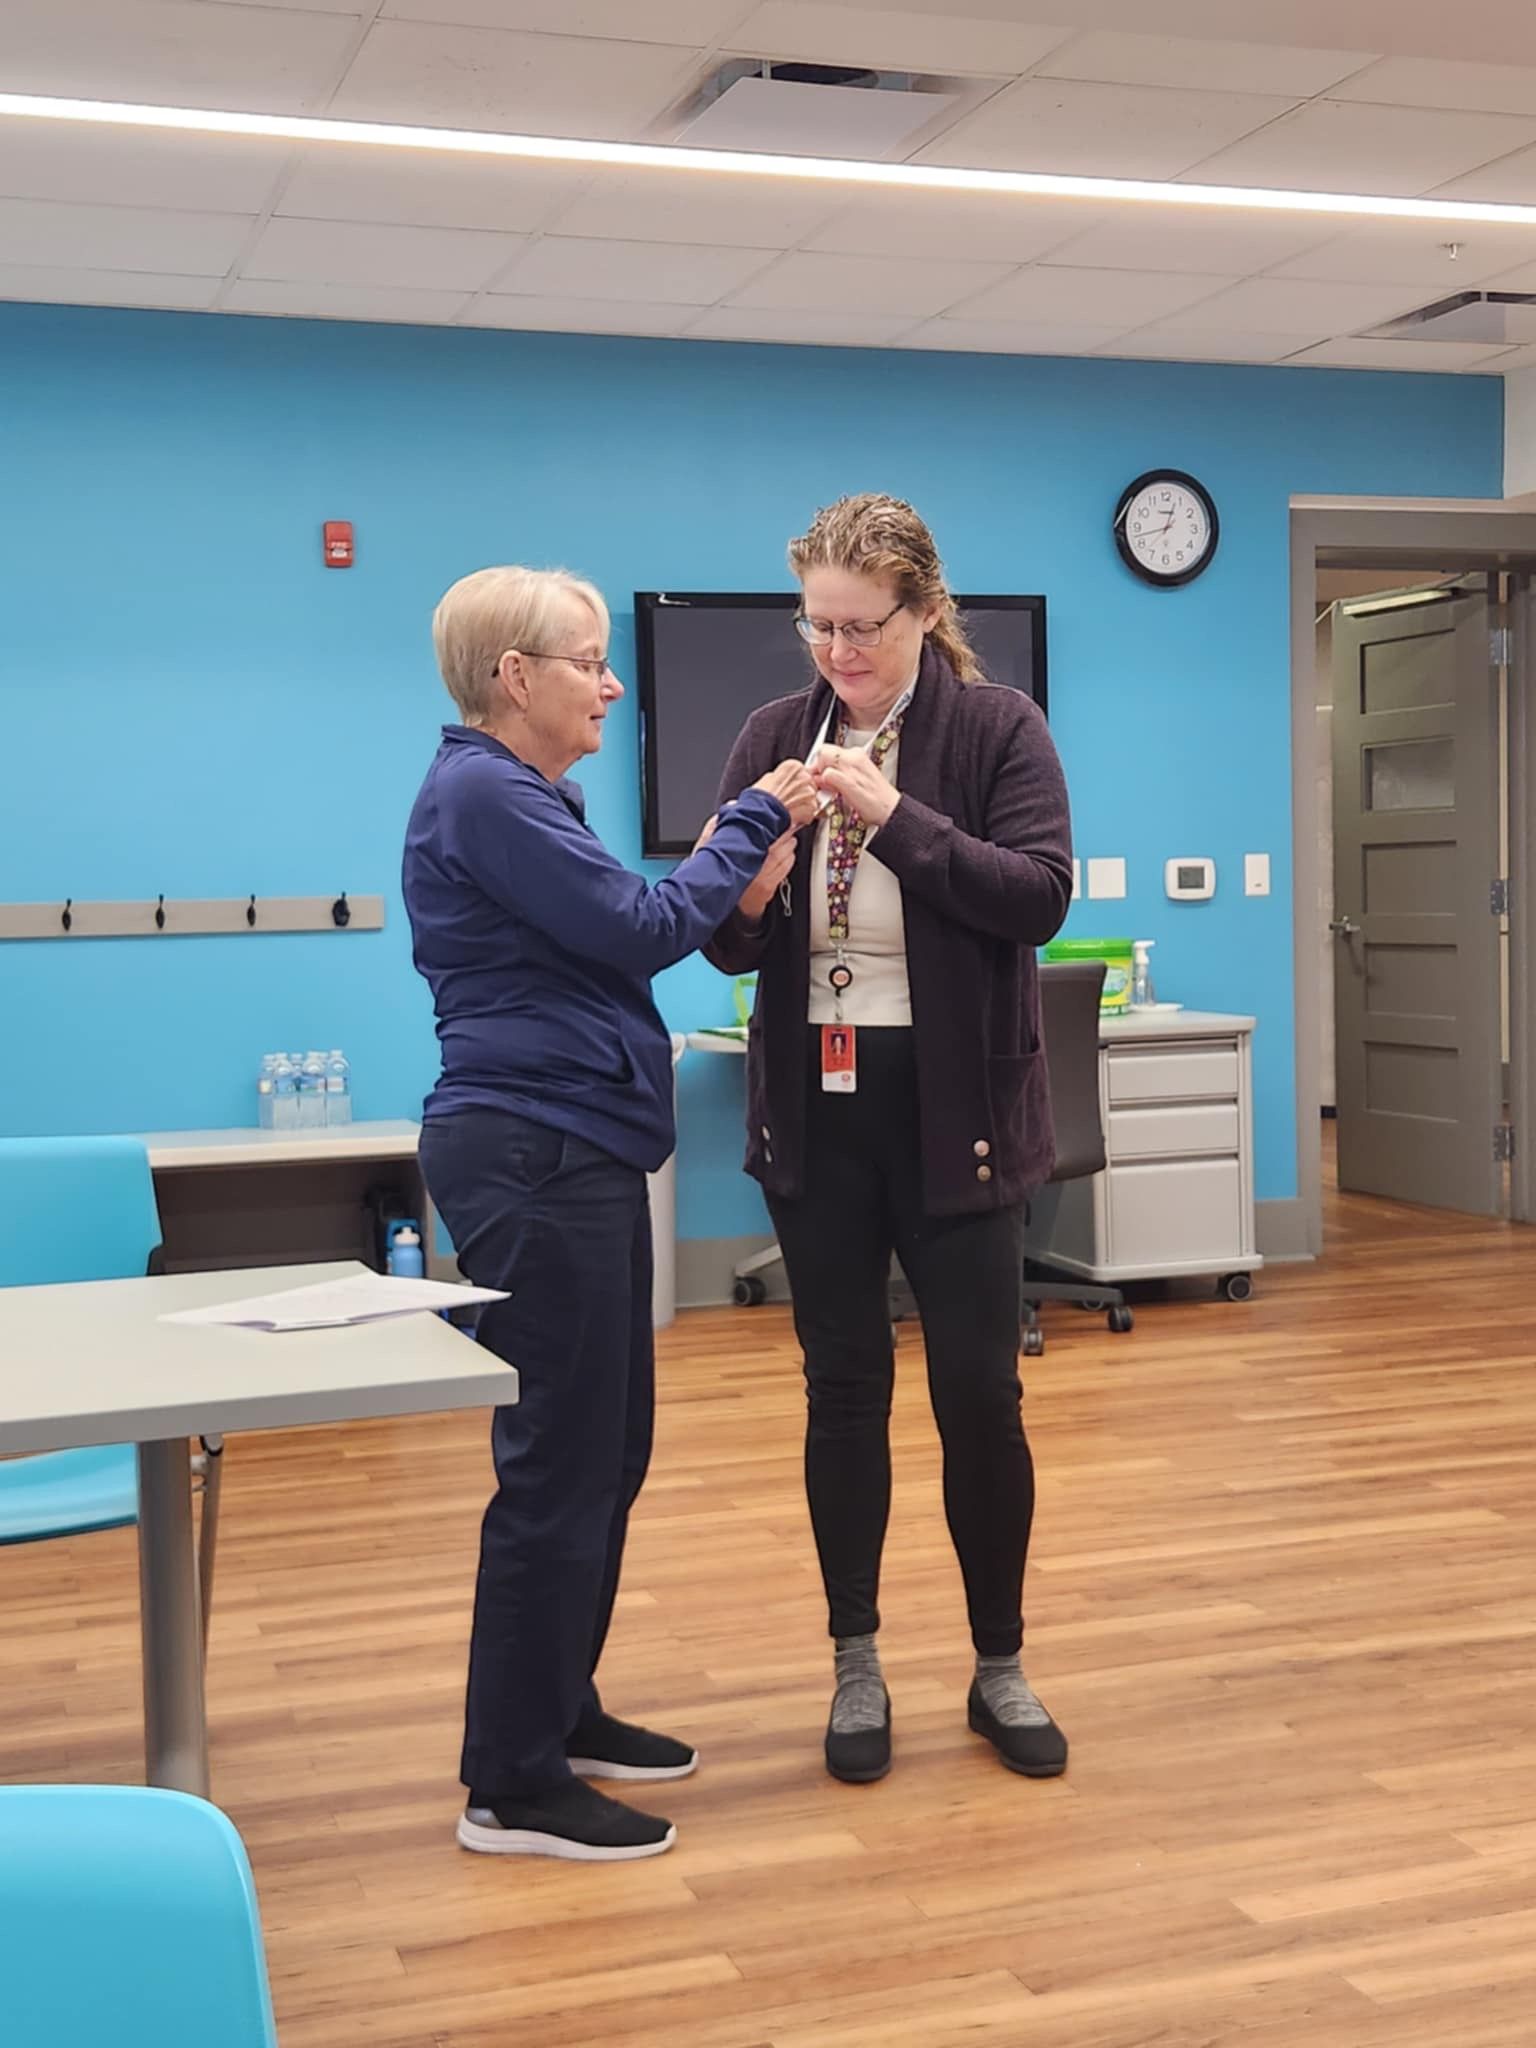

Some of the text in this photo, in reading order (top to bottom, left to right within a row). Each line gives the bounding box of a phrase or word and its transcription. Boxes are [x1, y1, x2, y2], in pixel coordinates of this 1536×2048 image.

[1148, 495, 1157, 506] 11
[1160, 492, 1172, 502] 12
[1178, 497, 1182, 506] 1
[1137, 507, 1150, 519] 10
[1186, 508, 1194, 519] 2
[1133, 522, 1141, 532] 9
[1190, 524, 1198, 534] 3
[1137, 538, 1146, 549] 8
[1186, 540, 1194, 550] 4
[1148, 549, 1156, 560] 7
[1161, 554, 1170, 565] 6
[1175, 550, 1184, 561] 5
